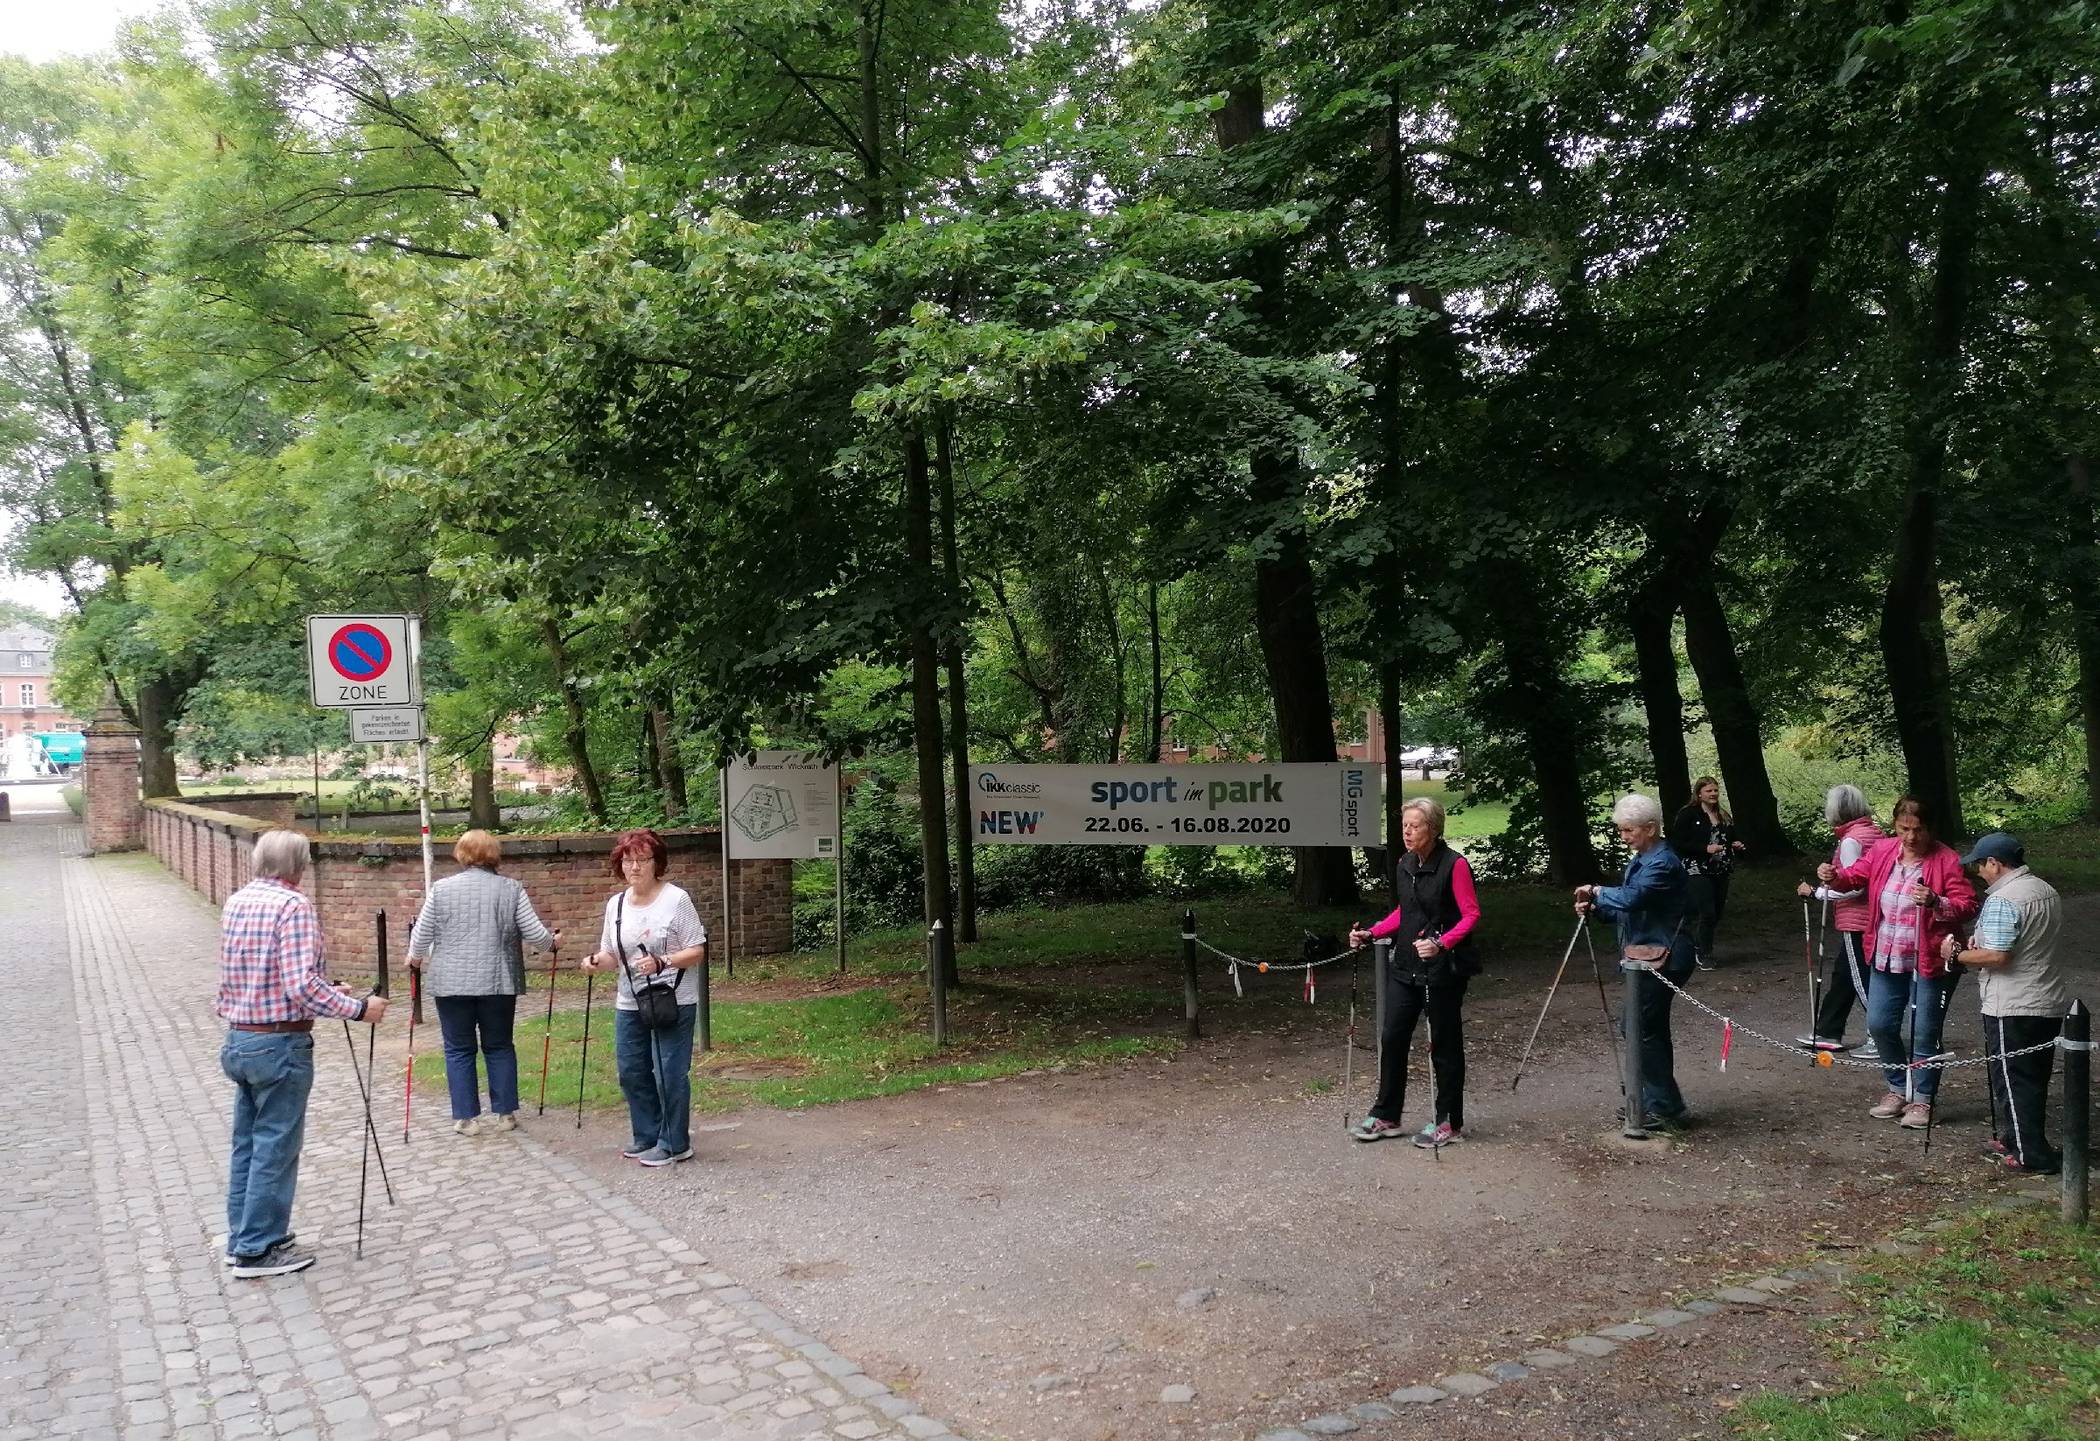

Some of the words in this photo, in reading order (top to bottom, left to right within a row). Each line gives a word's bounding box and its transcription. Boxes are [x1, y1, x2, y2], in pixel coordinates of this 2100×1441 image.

[339, 685, 387, 700] ZONE
[1091, 776, 1177, 810] sport
[1184, 782, 1204, 801] im
[1208, 773, 1283, 810] park
[1347, 770, 1364, 798] MG
[1085, 817, 1149, 833] 22.06.
[1170, 817, 1291, 833] 16.08.2020
[1345, 799, 1359, 837] sport
